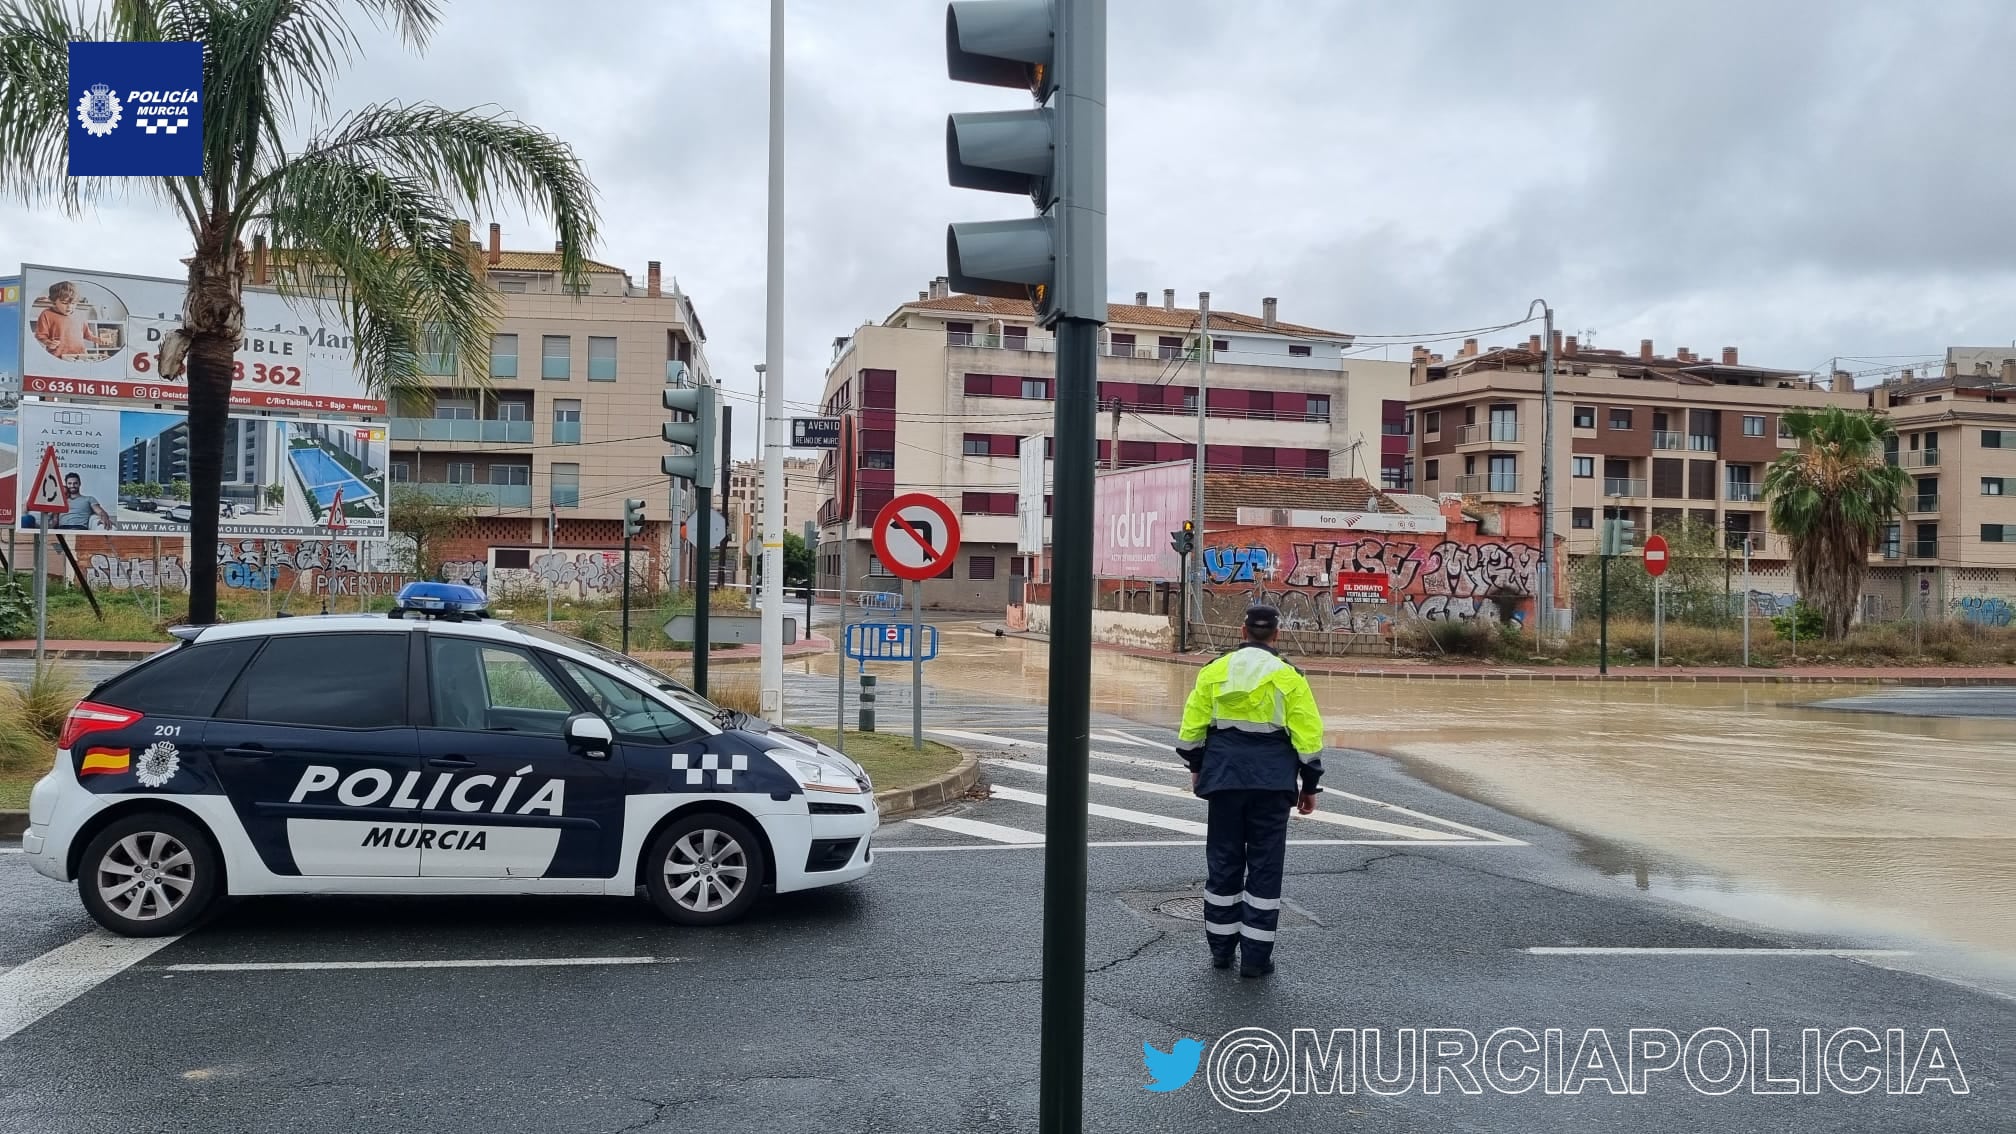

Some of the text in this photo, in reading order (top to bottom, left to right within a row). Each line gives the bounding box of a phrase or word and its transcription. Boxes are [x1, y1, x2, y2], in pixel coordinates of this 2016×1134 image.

[147, 327, 293, 356] DIBLE
[252, 363, 301, 387] 362
[48, 381, 119, 396] 636 116 116
[315, 400, 323, 408] 12
[808, 421, 840, 431] AVENID
[823, 437, 839, 445] MURC
[1320, 514, 1337, 524] foro
[1353, 584, 1383, 592] DONATO
[154, 725, 181, 736] 201
[289, 764, 565, 816] POLICÍA
[361, 827, 487, 851] MURCIA
